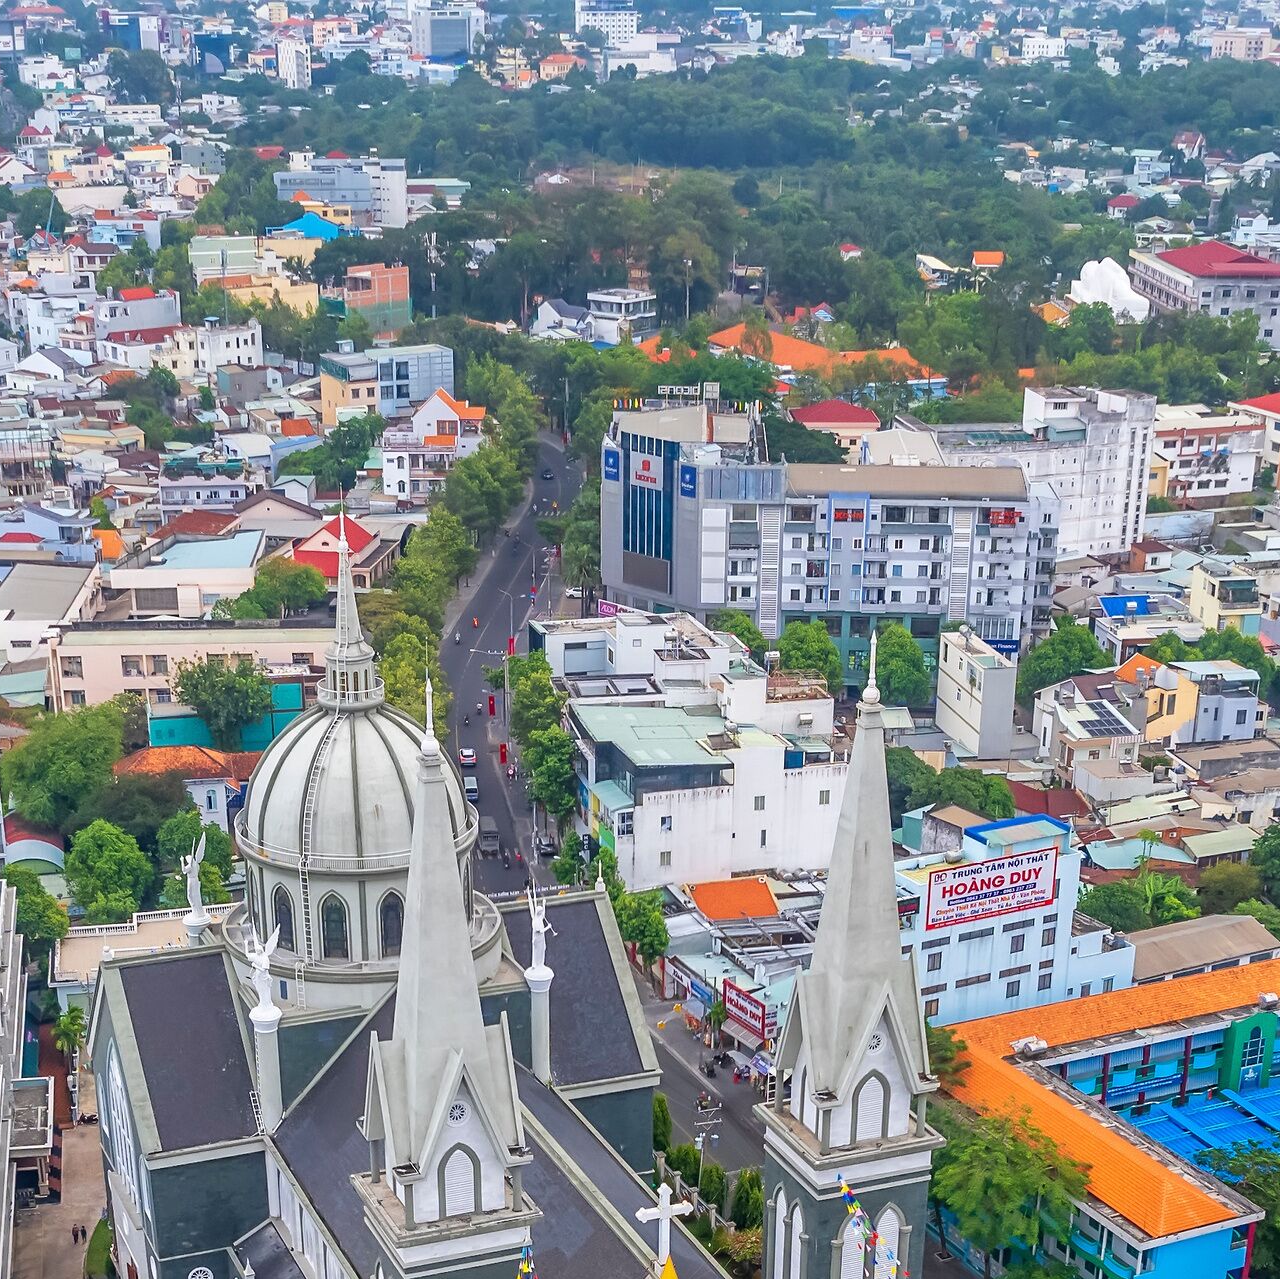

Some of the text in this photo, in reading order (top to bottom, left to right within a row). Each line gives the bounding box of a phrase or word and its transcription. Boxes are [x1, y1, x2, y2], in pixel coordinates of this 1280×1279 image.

[952, 852, 1049, 880] TRUNG TÂM NỘI THẤT
[942, 866, 1043, 899] HOÀNG DUY
